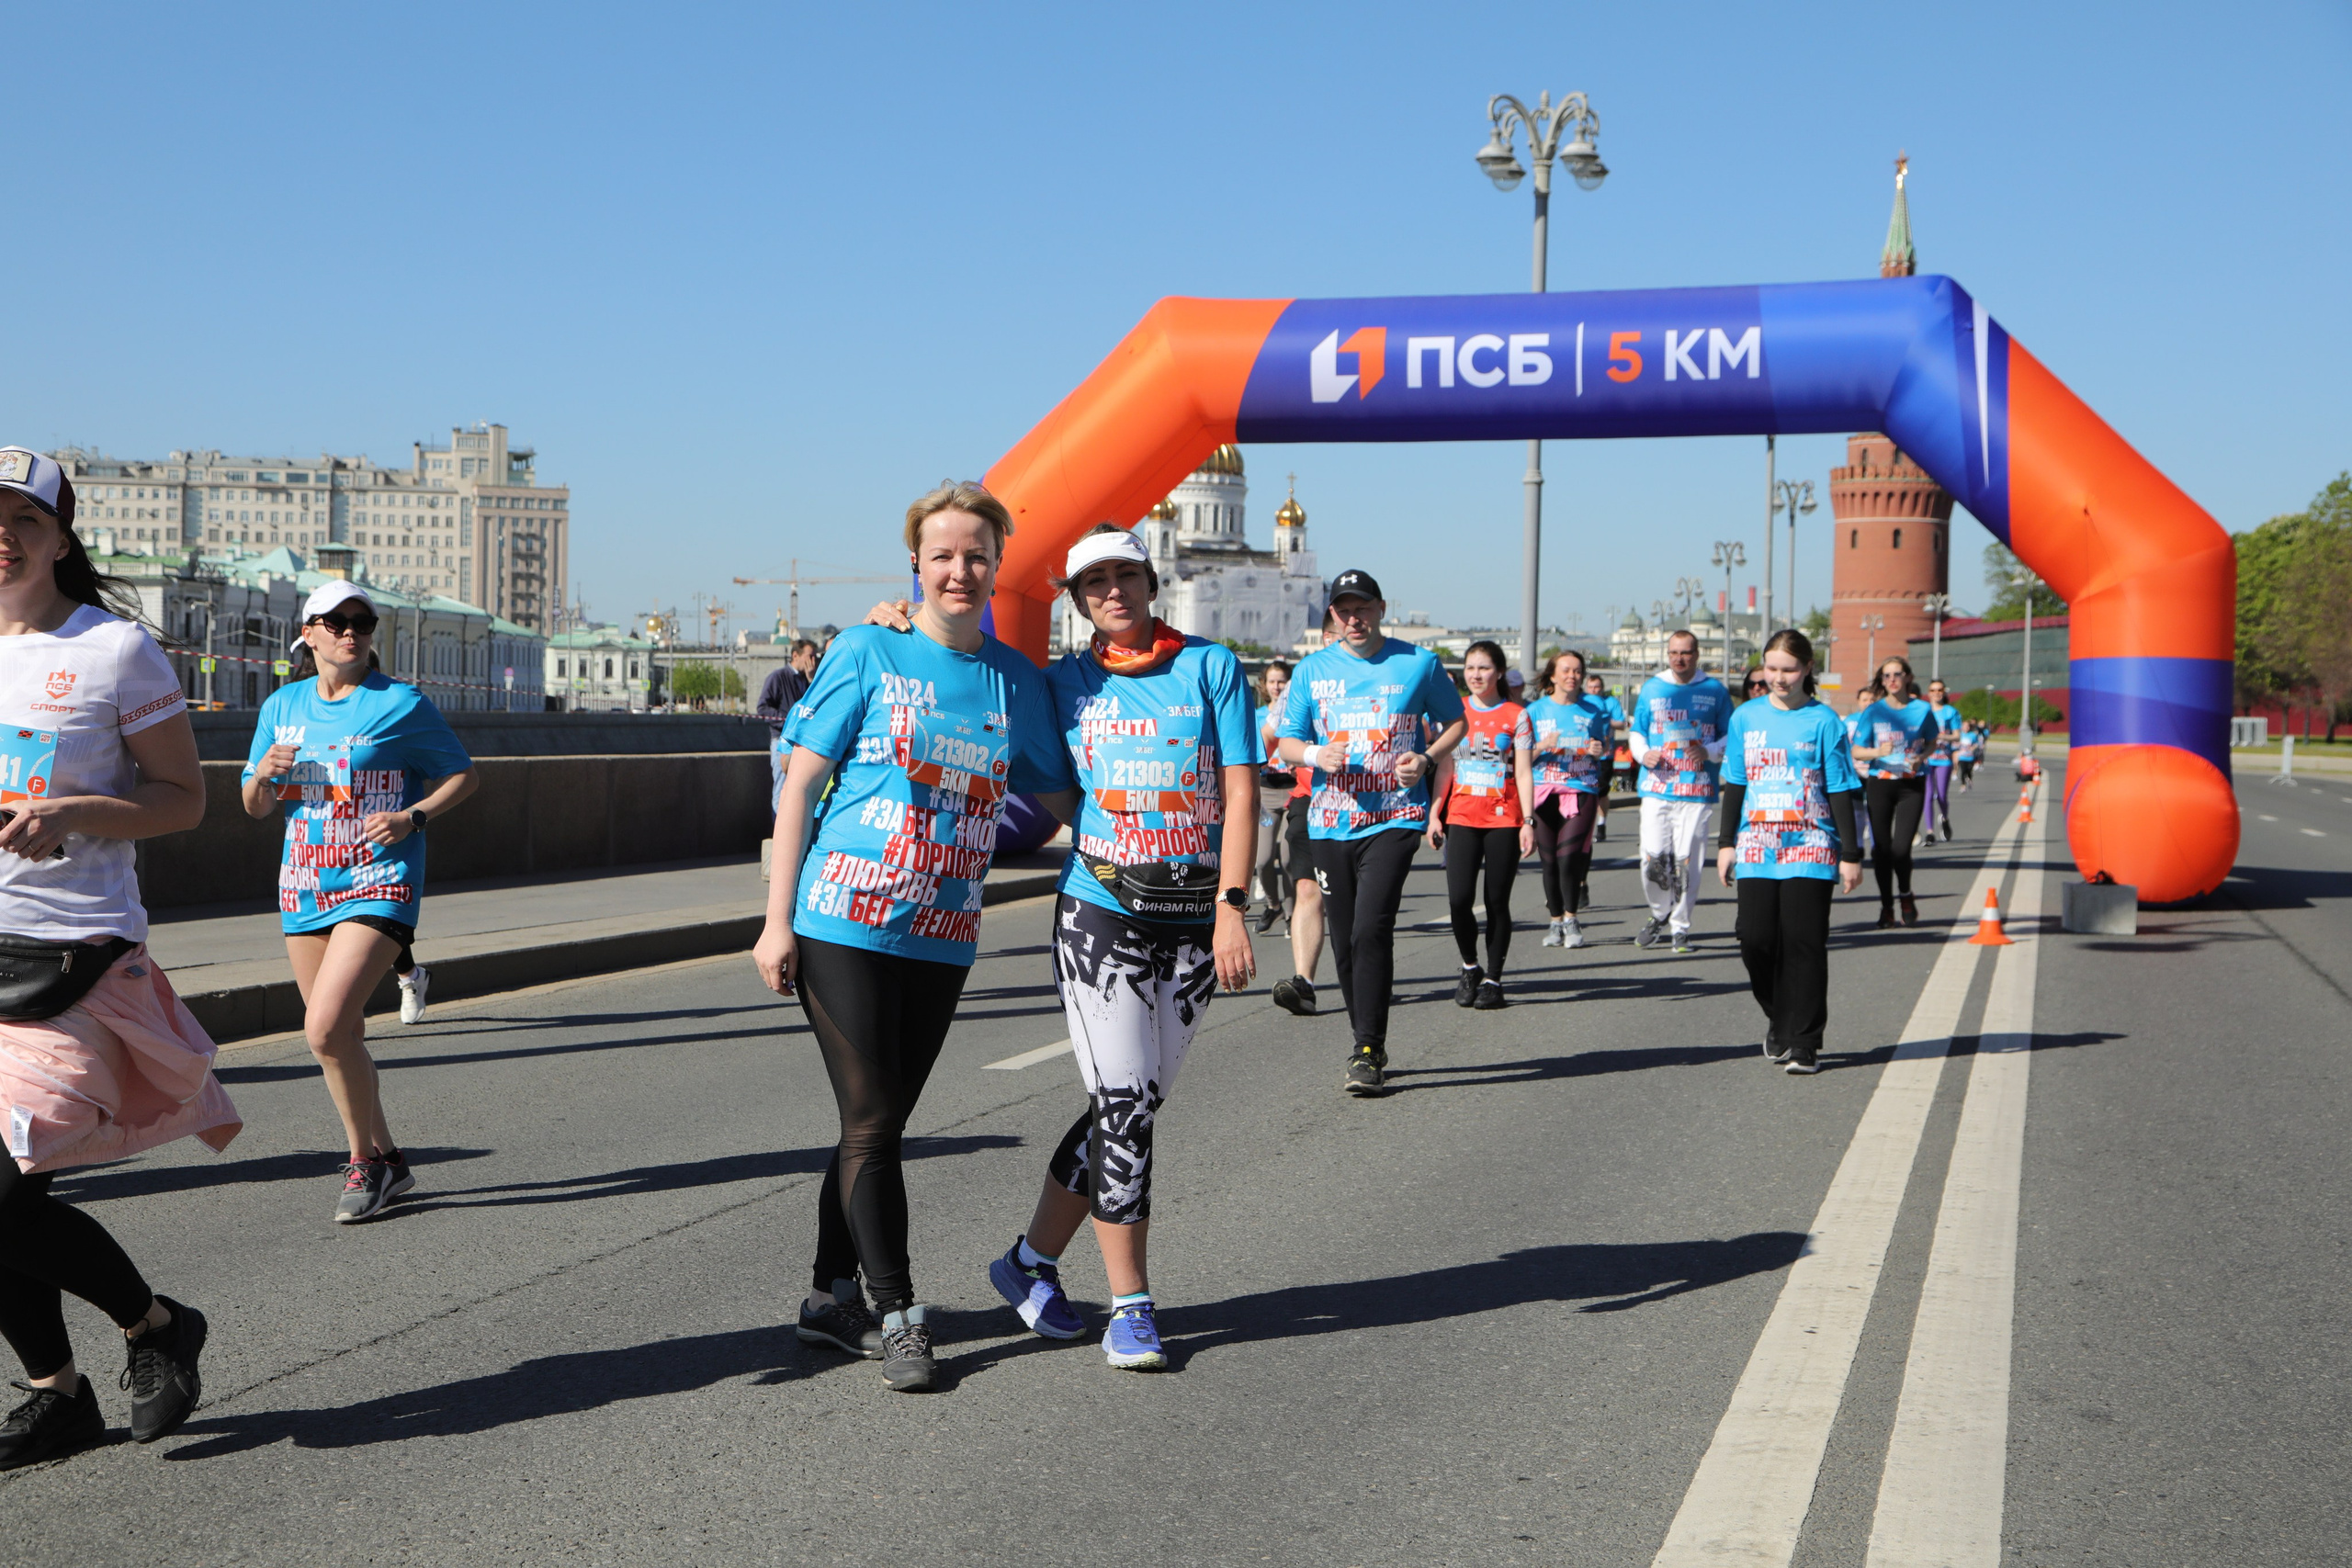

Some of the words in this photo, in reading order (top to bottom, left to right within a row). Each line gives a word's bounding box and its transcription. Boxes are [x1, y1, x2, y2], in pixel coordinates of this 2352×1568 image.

[1407, 333, 1554, 389] ПСБ
[1606, 332, 1643, 382] 5
[1664, 326, 1761, 381] КМ
[45, 682, 74, 691] ПСБ
[880, 671, 937, 708] 2024
[1310, 679, 1346, 700] 2024
[29, 703, 76, 715] СПОРТ
[930, 711, 945, 720] ПСБ
[1073, 695, 1120, 719] 2024
[1080, 718, 1158, 744] #МЕЧТА
[1340, 712, 1376, 728] 20176
[1744, 730, 1767, 749] 024
[931, 734, 989, 773] 21302
[291, 761, 335, 783] 23103
[995, 762, 1002, 773] F
[1112, 760, 1176, 787] 21303
[1185, 773, 1193, 784] F
[32, 779, 42, 791] F
[353, 770, 405, 795] #ЦЕЛЬ
[939, 766, 972, 795] 5KM
[1327, 773, 1397, 793] #ГОРДОСТЬ
[1125, 790, 1159, 811] 5KM
[1758, 793, 1793, 808] 25370
[859, 795, 937, 840] #ЗАБЕГ
[350, 863, 400, 890] 2024
[820, 851, 943, 907] #ЛЮБОВЬ
[807, 879, 896, 929] #ЗАБЕГ
